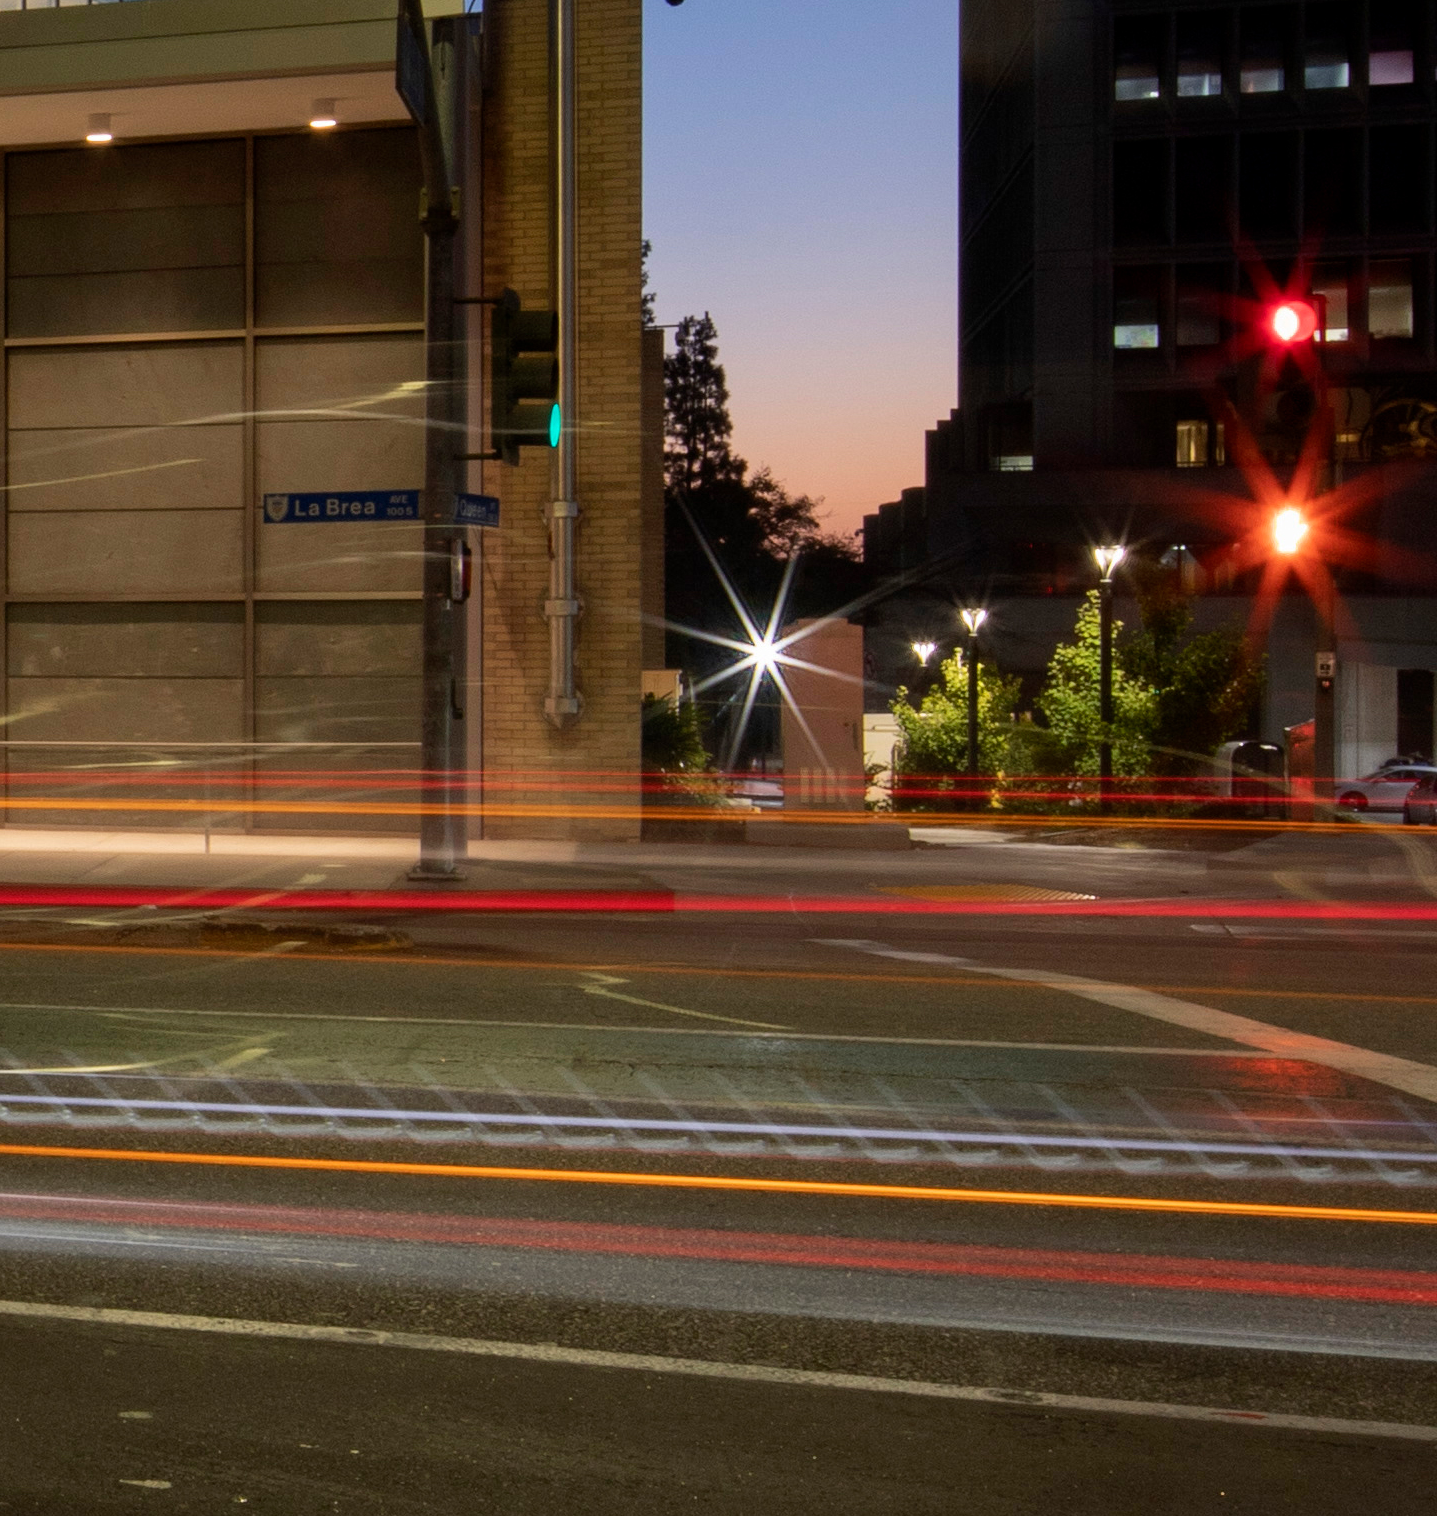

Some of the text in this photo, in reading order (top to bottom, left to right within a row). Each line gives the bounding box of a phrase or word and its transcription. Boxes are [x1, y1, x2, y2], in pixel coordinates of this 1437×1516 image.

[389, 494, 408, 504] AVE
[294, 498, 375, 517] La Brea
[387, 507, 405, 516] 100
